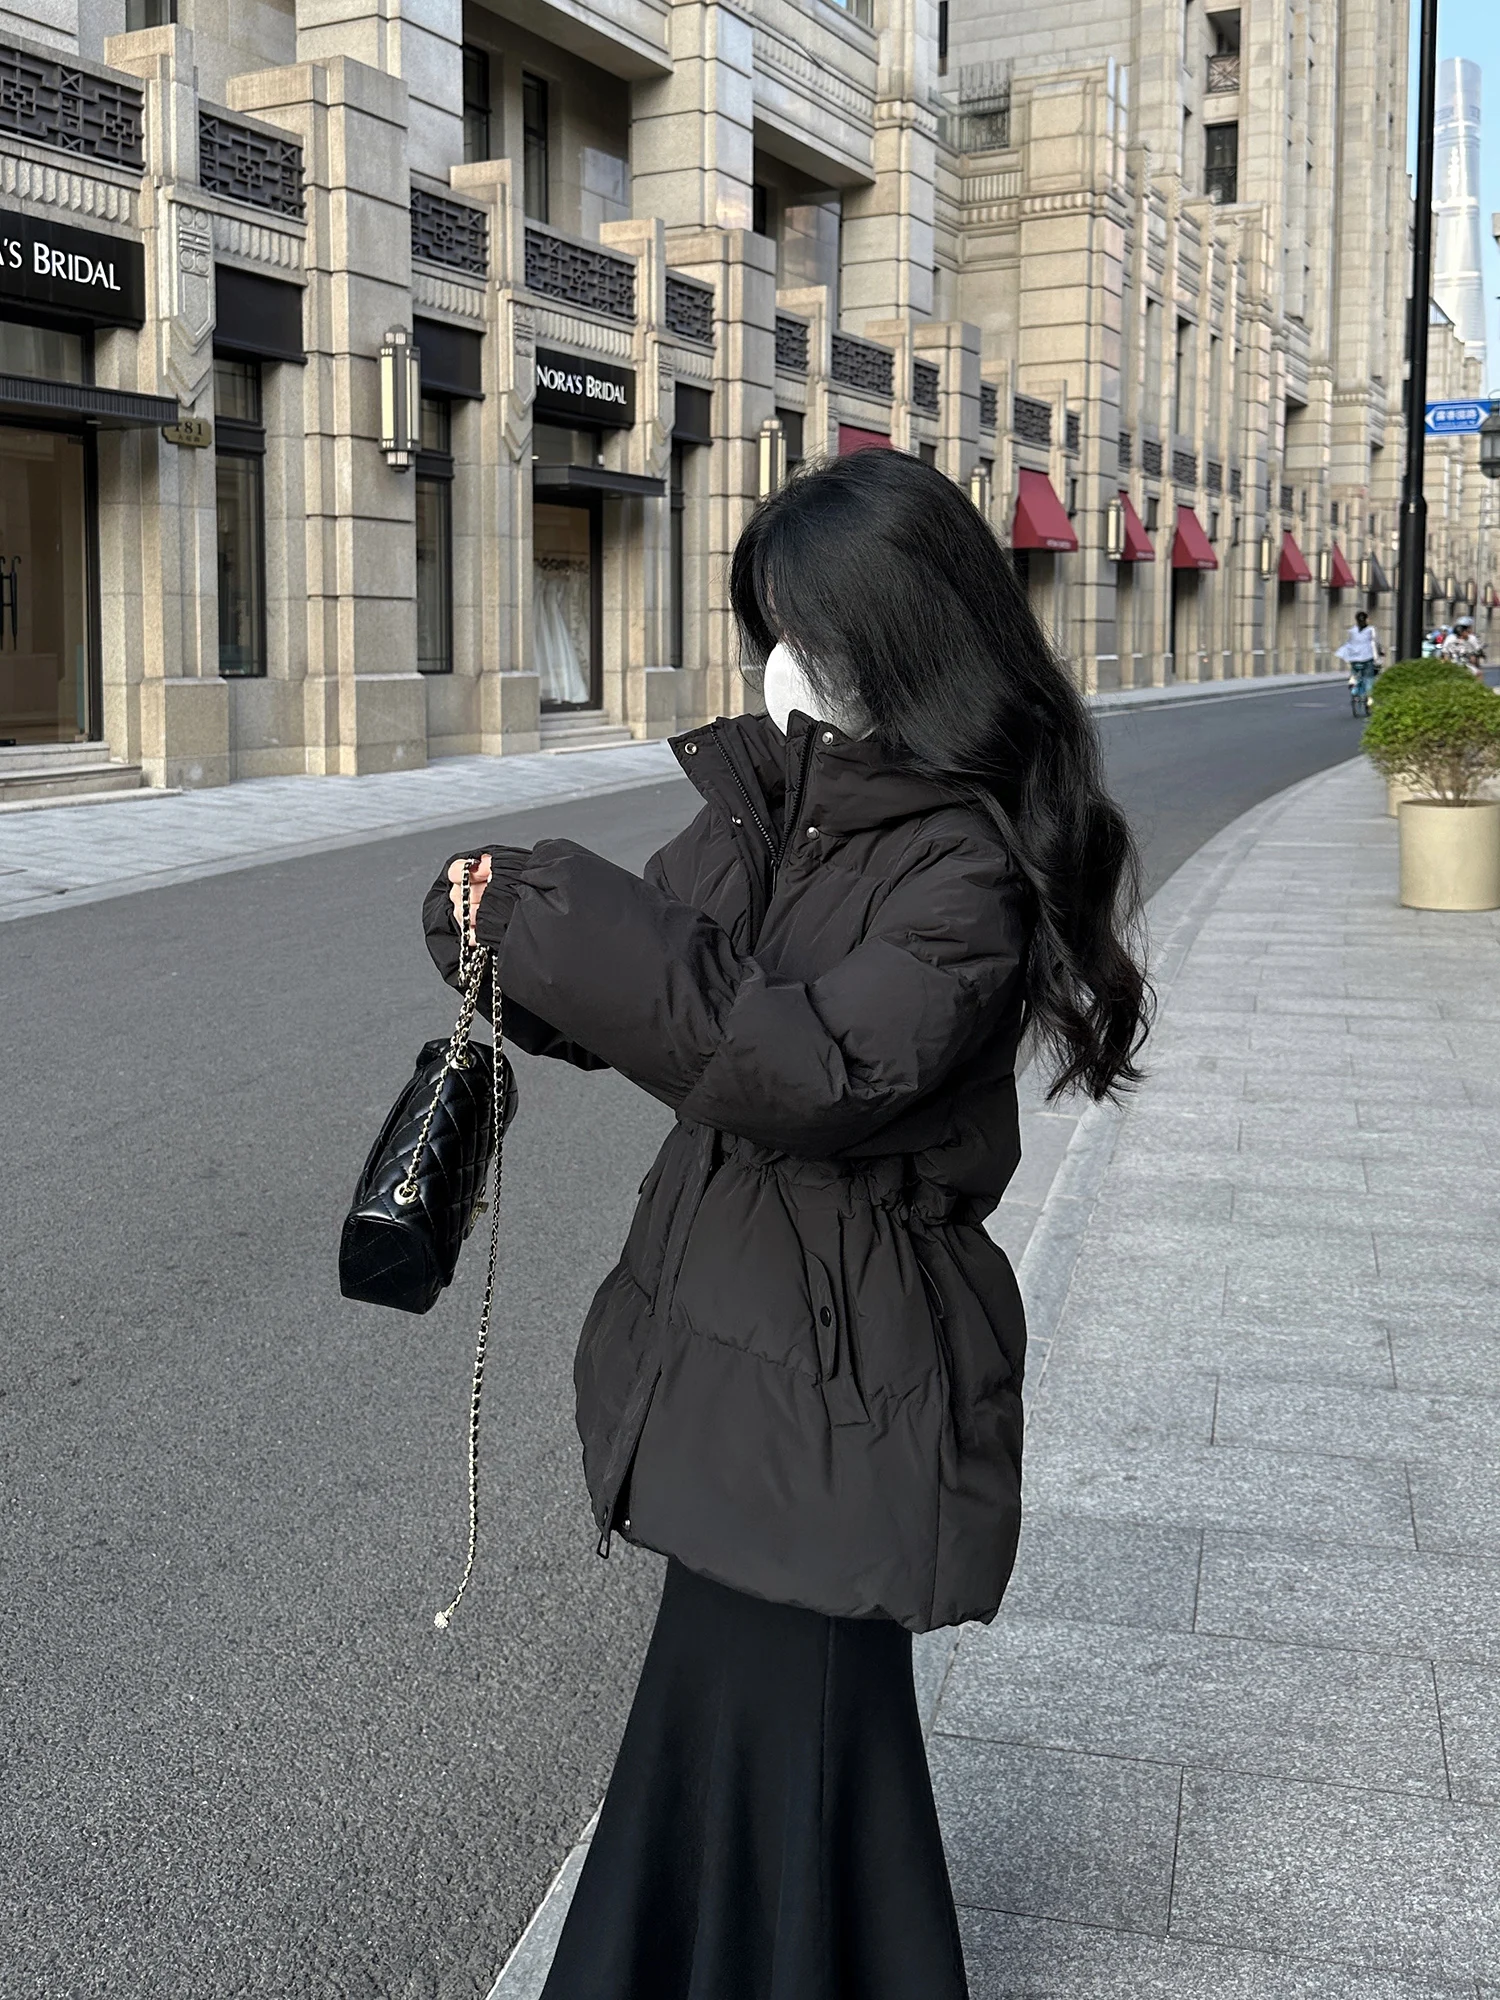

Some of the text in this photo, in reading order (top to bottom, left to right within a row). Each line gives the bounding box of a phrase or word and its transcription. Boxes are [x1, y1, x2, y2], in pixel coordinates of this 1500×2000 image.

[0, 238, 121, 291] 'S BRIDAL
[536, 364, 627, 405] NORA'S BRIDAL
